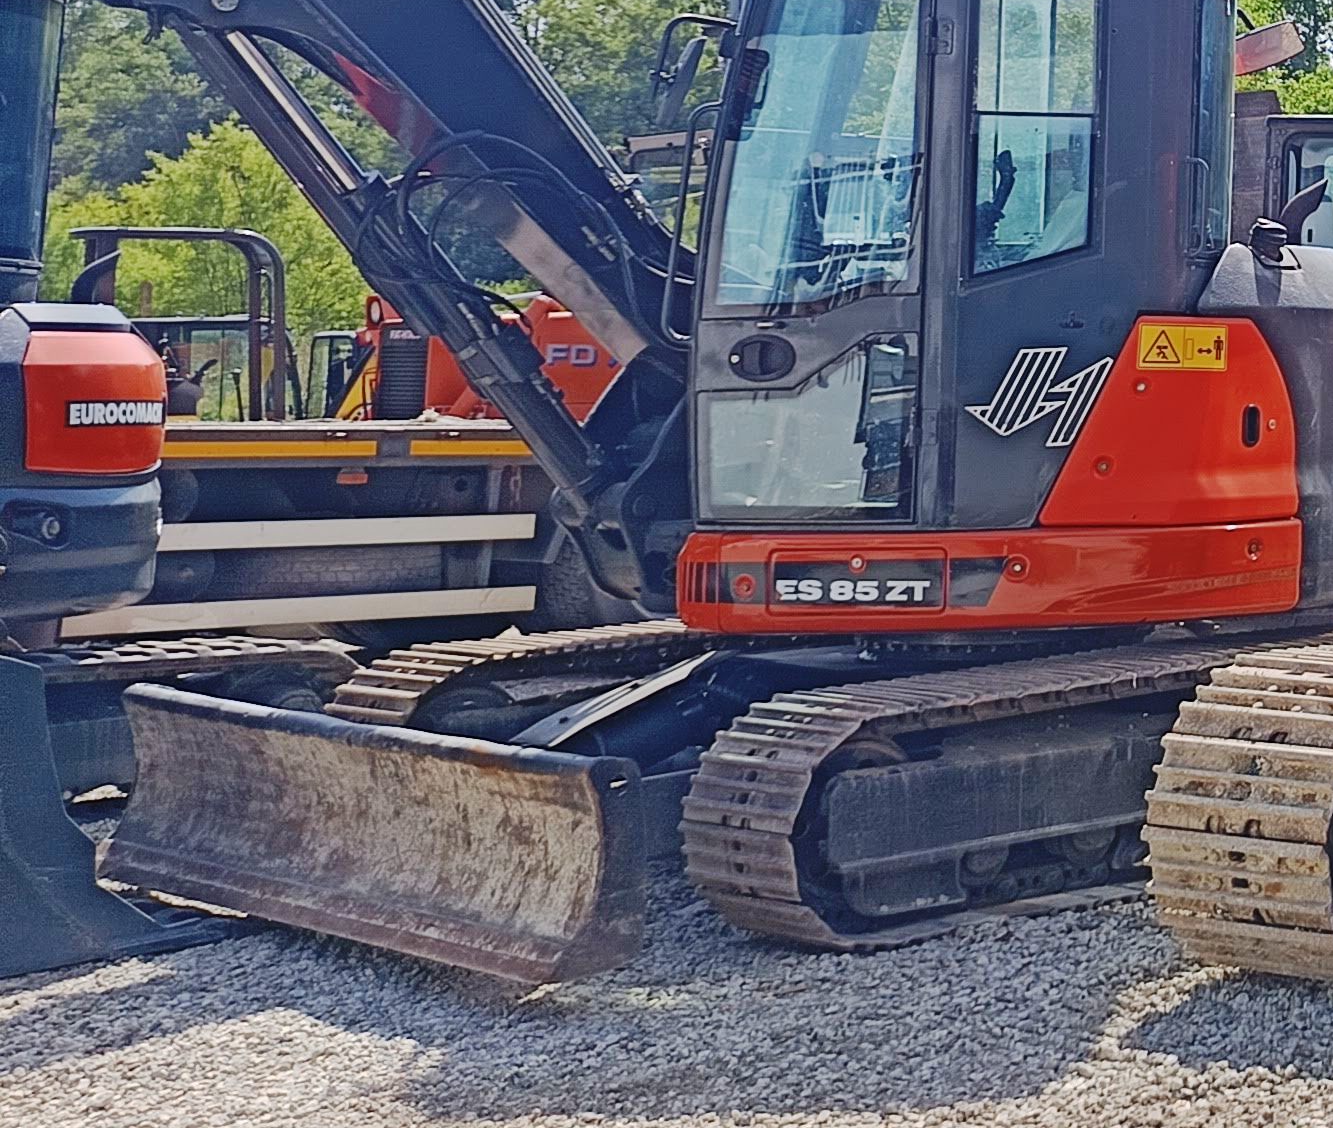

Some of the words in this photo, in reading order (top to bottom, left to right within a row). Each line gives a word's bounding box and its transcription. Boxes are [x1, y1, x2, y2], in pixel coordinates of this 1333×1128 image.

[776, 579, 823, 601] ES
[829, 580, 879, 601] 85
[885, 580, 931, 602] ZT
